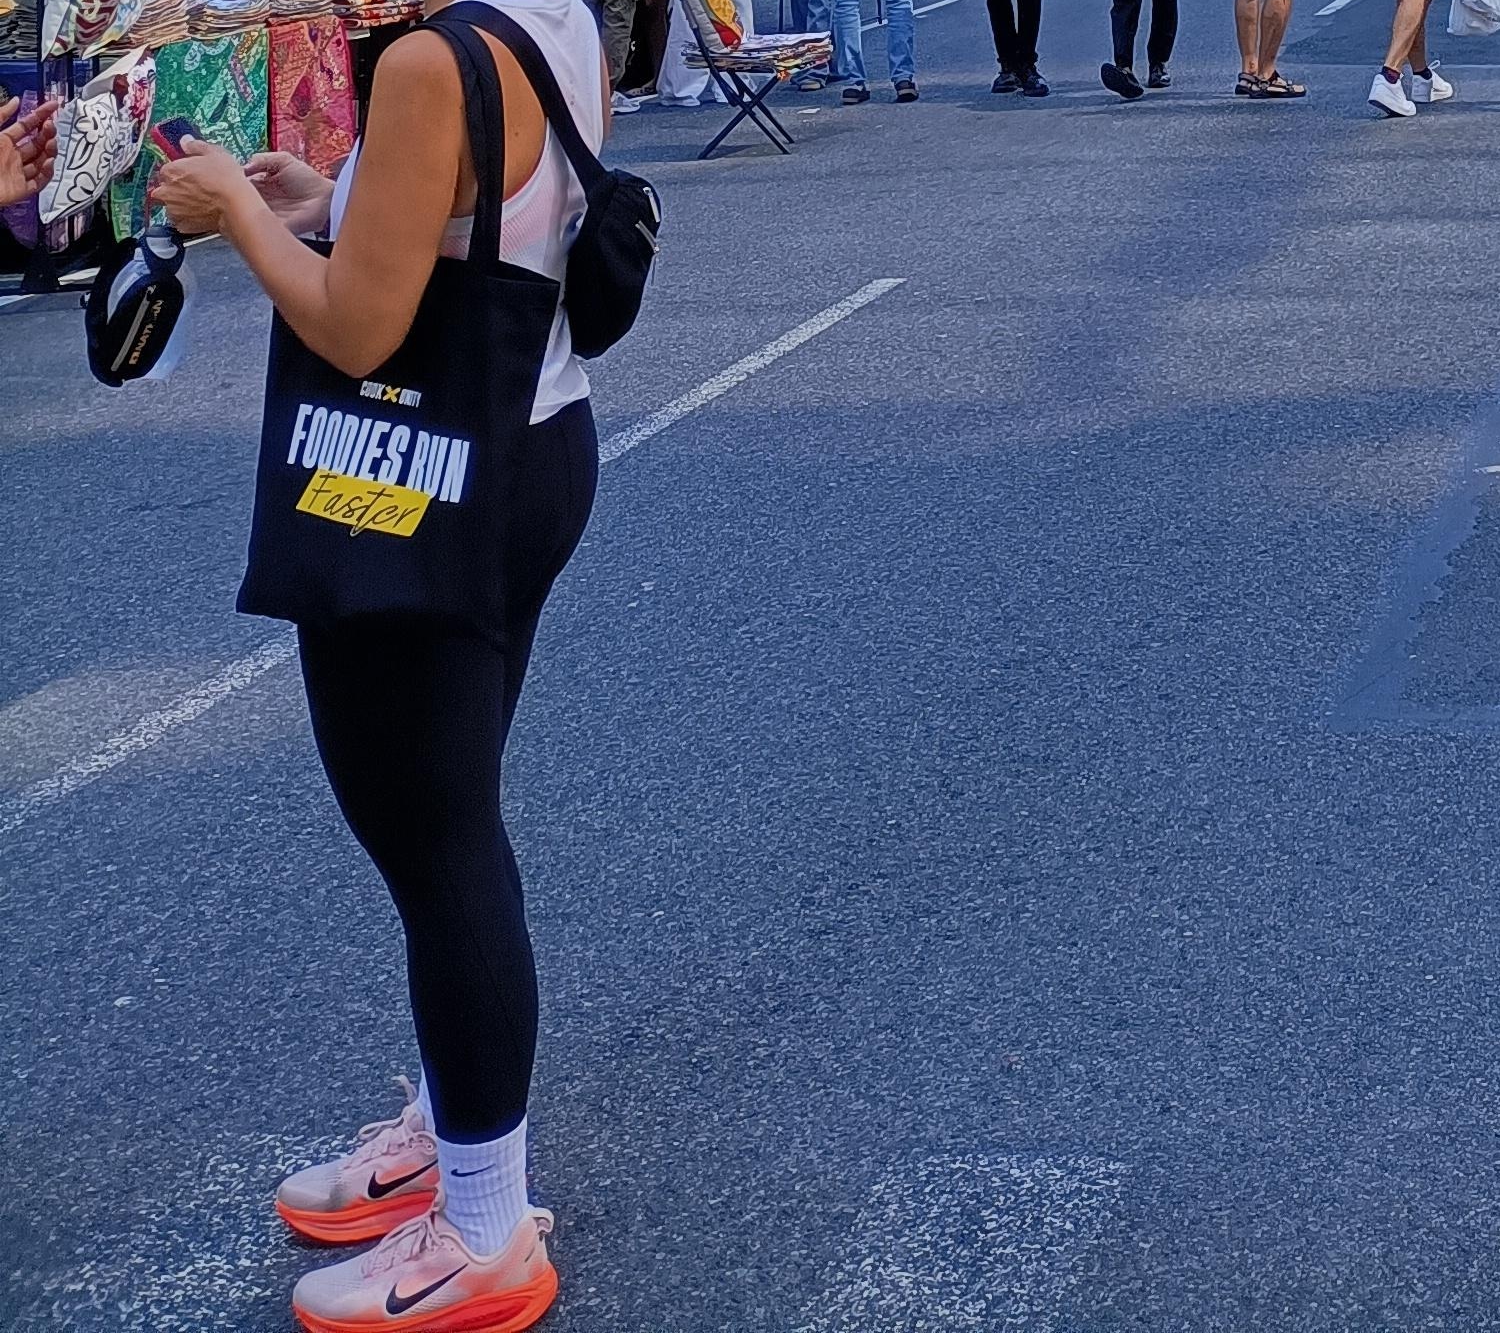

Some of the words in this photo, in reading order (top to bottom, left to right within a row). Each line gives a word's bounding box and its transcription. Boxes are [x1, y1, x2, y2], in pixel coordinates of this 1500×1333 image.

[360, 380, 386, 400] COOK
[286, 403, 411, 485] FOODIES
[406, 430, 470, 504] RUN
[302, 472, 420, 537] Faster
